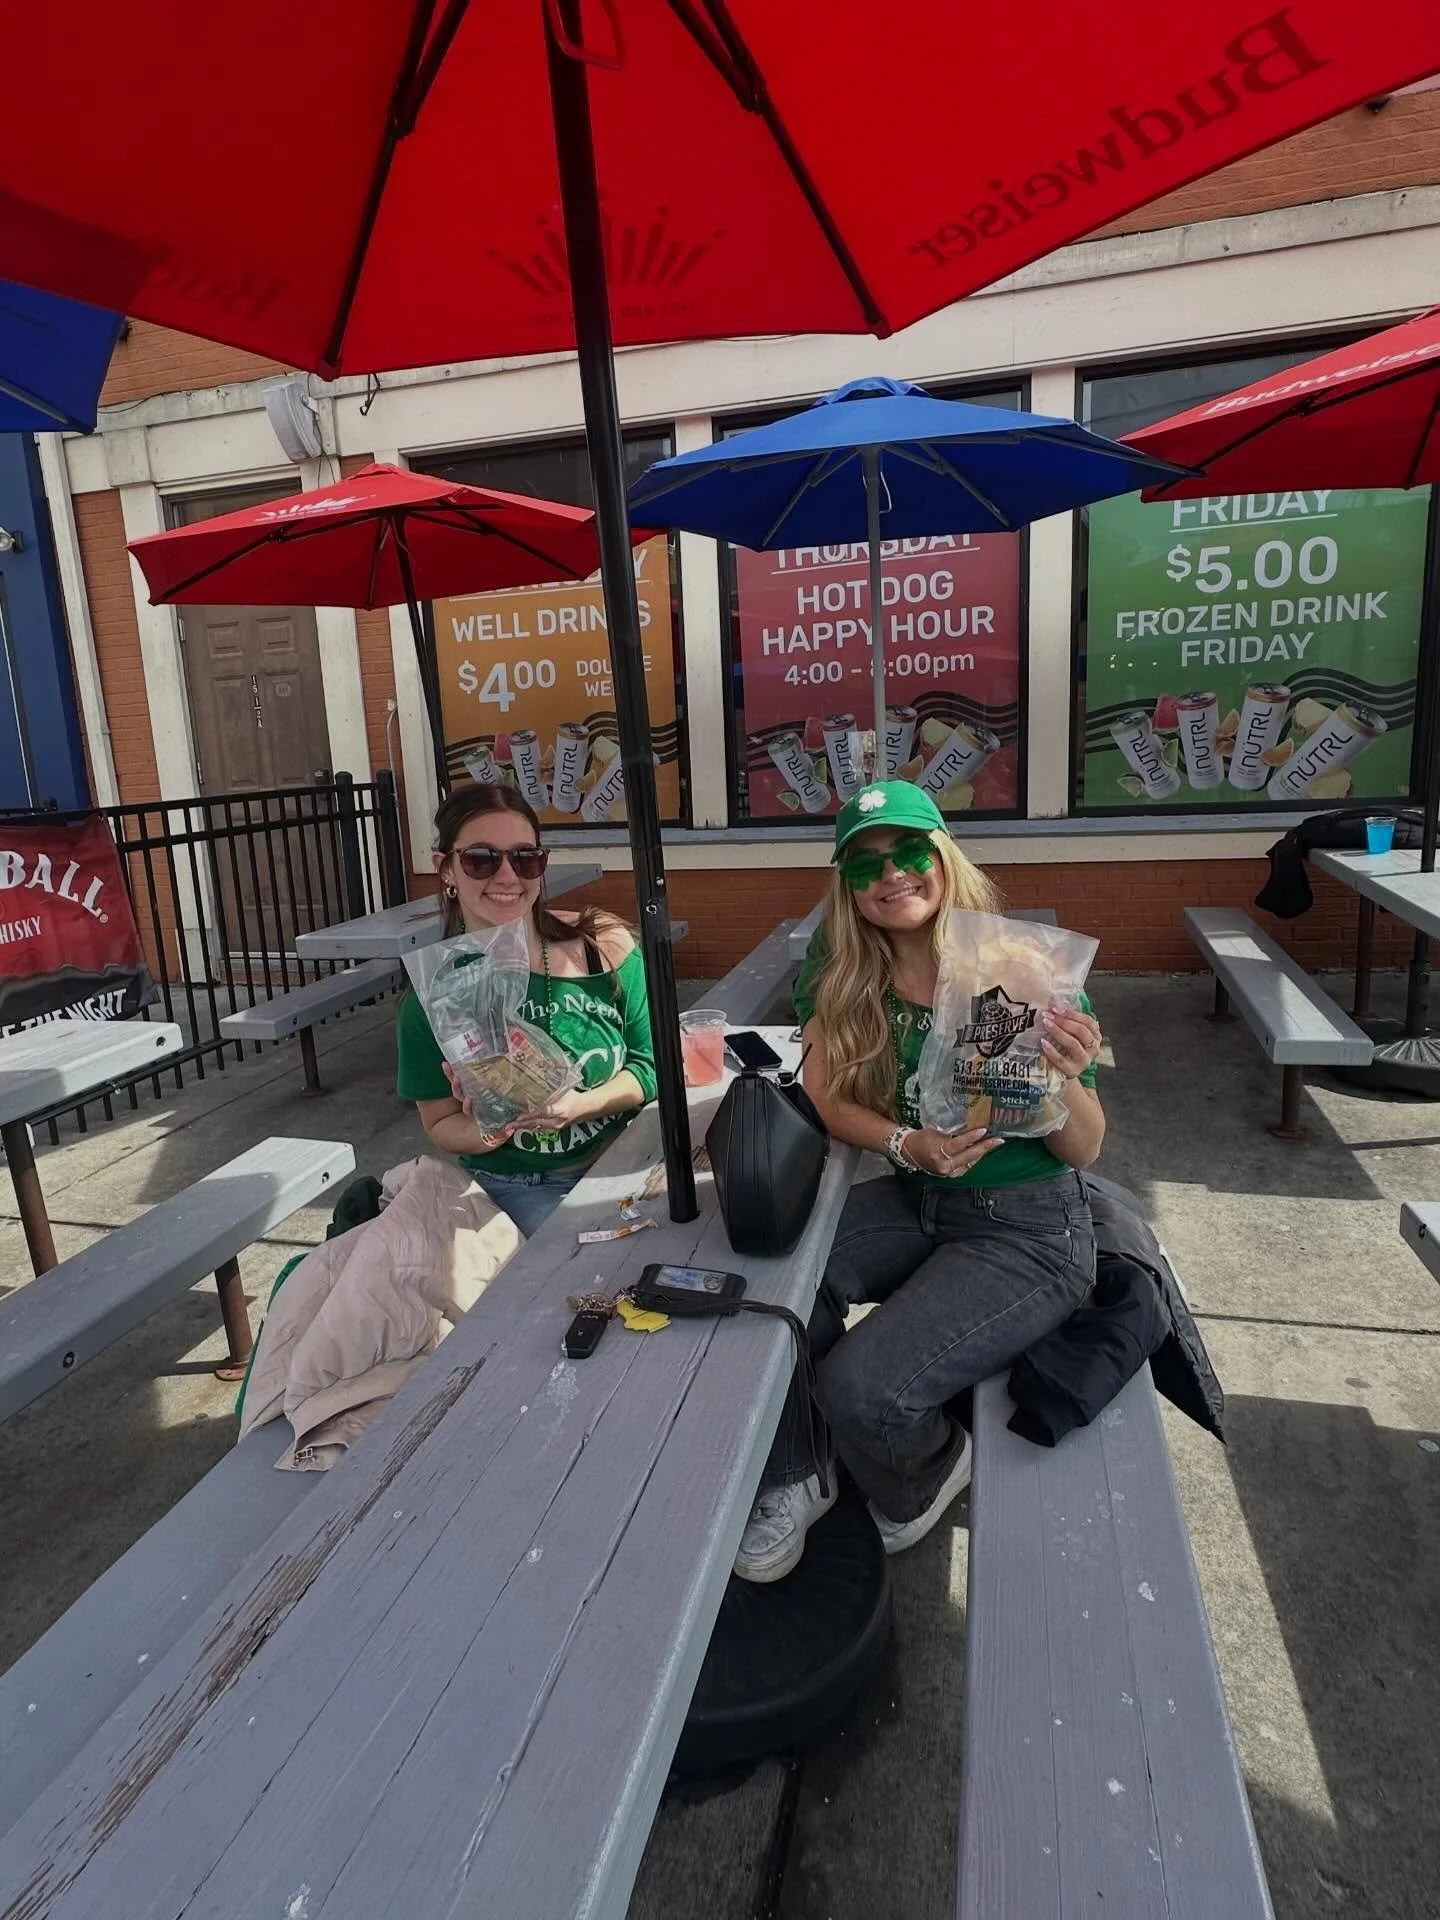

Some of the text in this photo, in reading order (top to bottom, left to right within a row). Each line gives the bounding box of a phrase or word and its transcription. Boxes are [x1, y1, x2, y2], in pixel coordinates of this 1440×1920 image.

[1171, 490, 1333, 527] FRIDAY
[1166, 535, 1339, 593] $5.00
[797, 570, 954, 615] HOT DOG
[452, 600, 651, 643] WELL DRINS
[762, 605, 995, 656] HAPPY HOUR
[1115, 591, 1388, 638] FROZEN DRINK
[576, 655, 652, 677] DOUE
[1181, 631, 1314, 667] FRIDAY
[584, 680, 615, 697] WE
[784, 660, 843, 686] 4:00
[64, 988, 127, 1021] NIGHT
[974, 1014, 1028, 1041] PRESERVE
